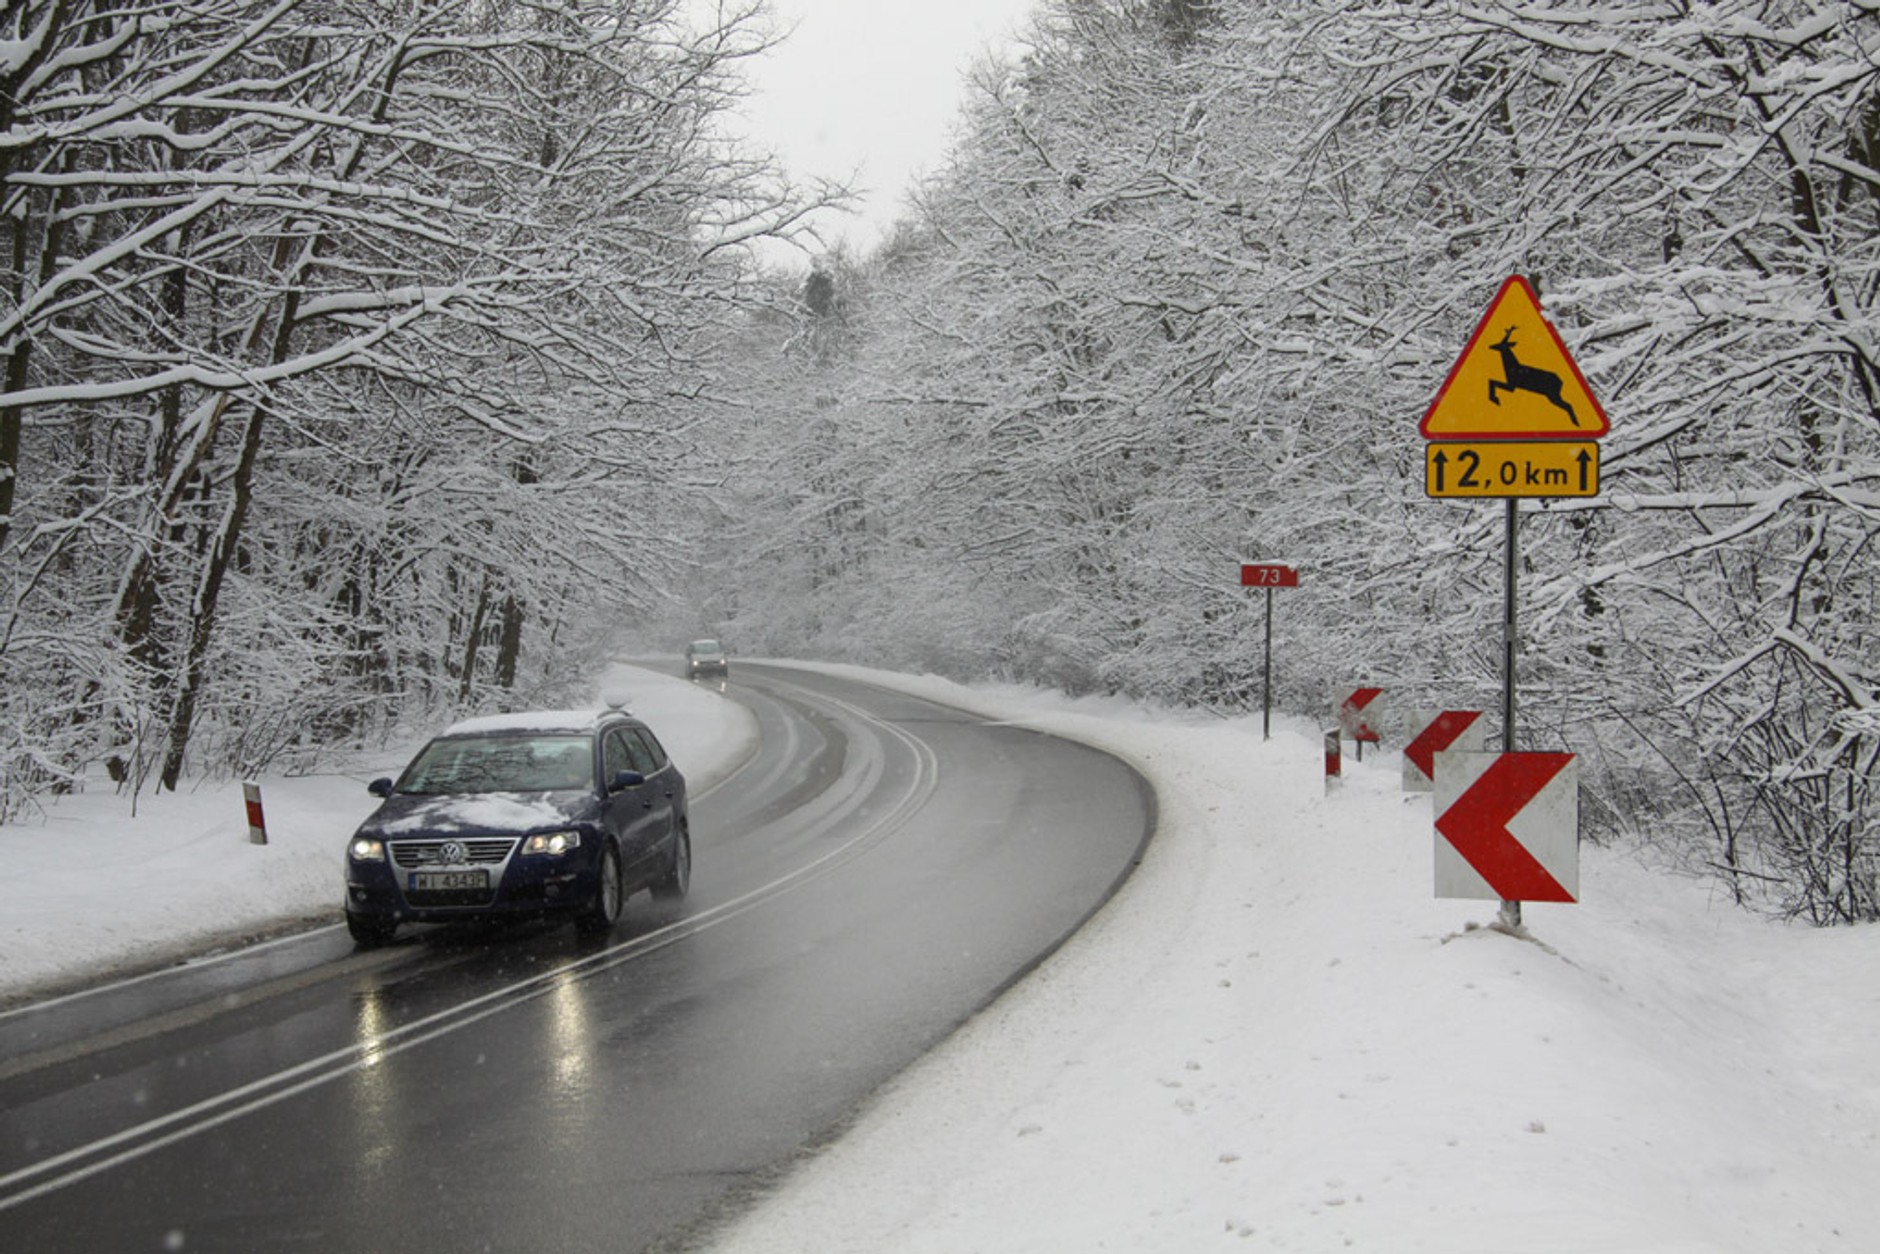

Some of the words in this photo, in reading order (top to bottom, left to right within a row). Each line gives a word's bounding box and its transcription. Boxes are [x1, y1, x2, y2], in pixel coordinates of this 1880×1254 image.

[1457, 449, 1518, 489] 2,0
[1525, 460, 1568, 486] km
[1259, 569, 1280, 584] 73
